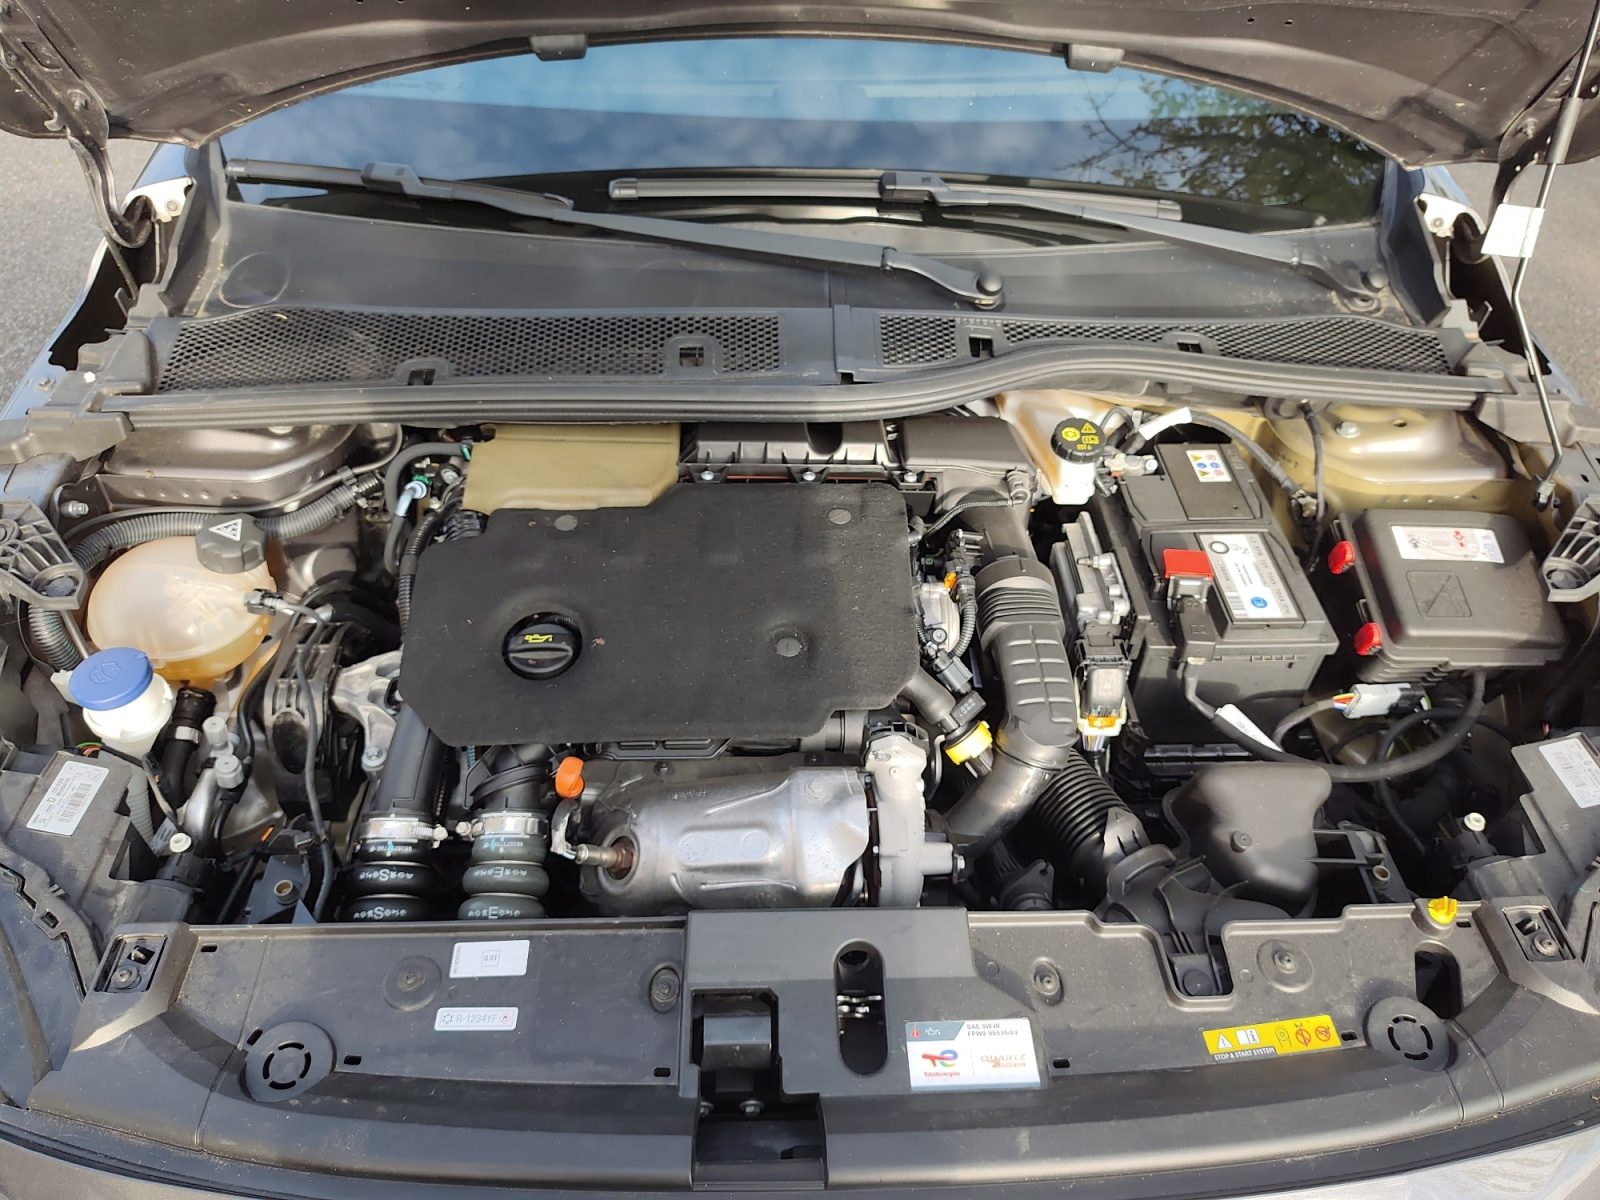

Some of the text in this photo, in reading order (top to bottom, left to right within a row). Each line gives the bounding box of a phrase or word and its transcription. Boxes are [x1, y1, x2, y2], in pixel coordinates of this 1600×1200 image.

[1214, 1054, 1229, 1062] STOP
[1235, 1049, 1252, 1058] START
[1253, 1046, 1275, 1056] SYSTEM
